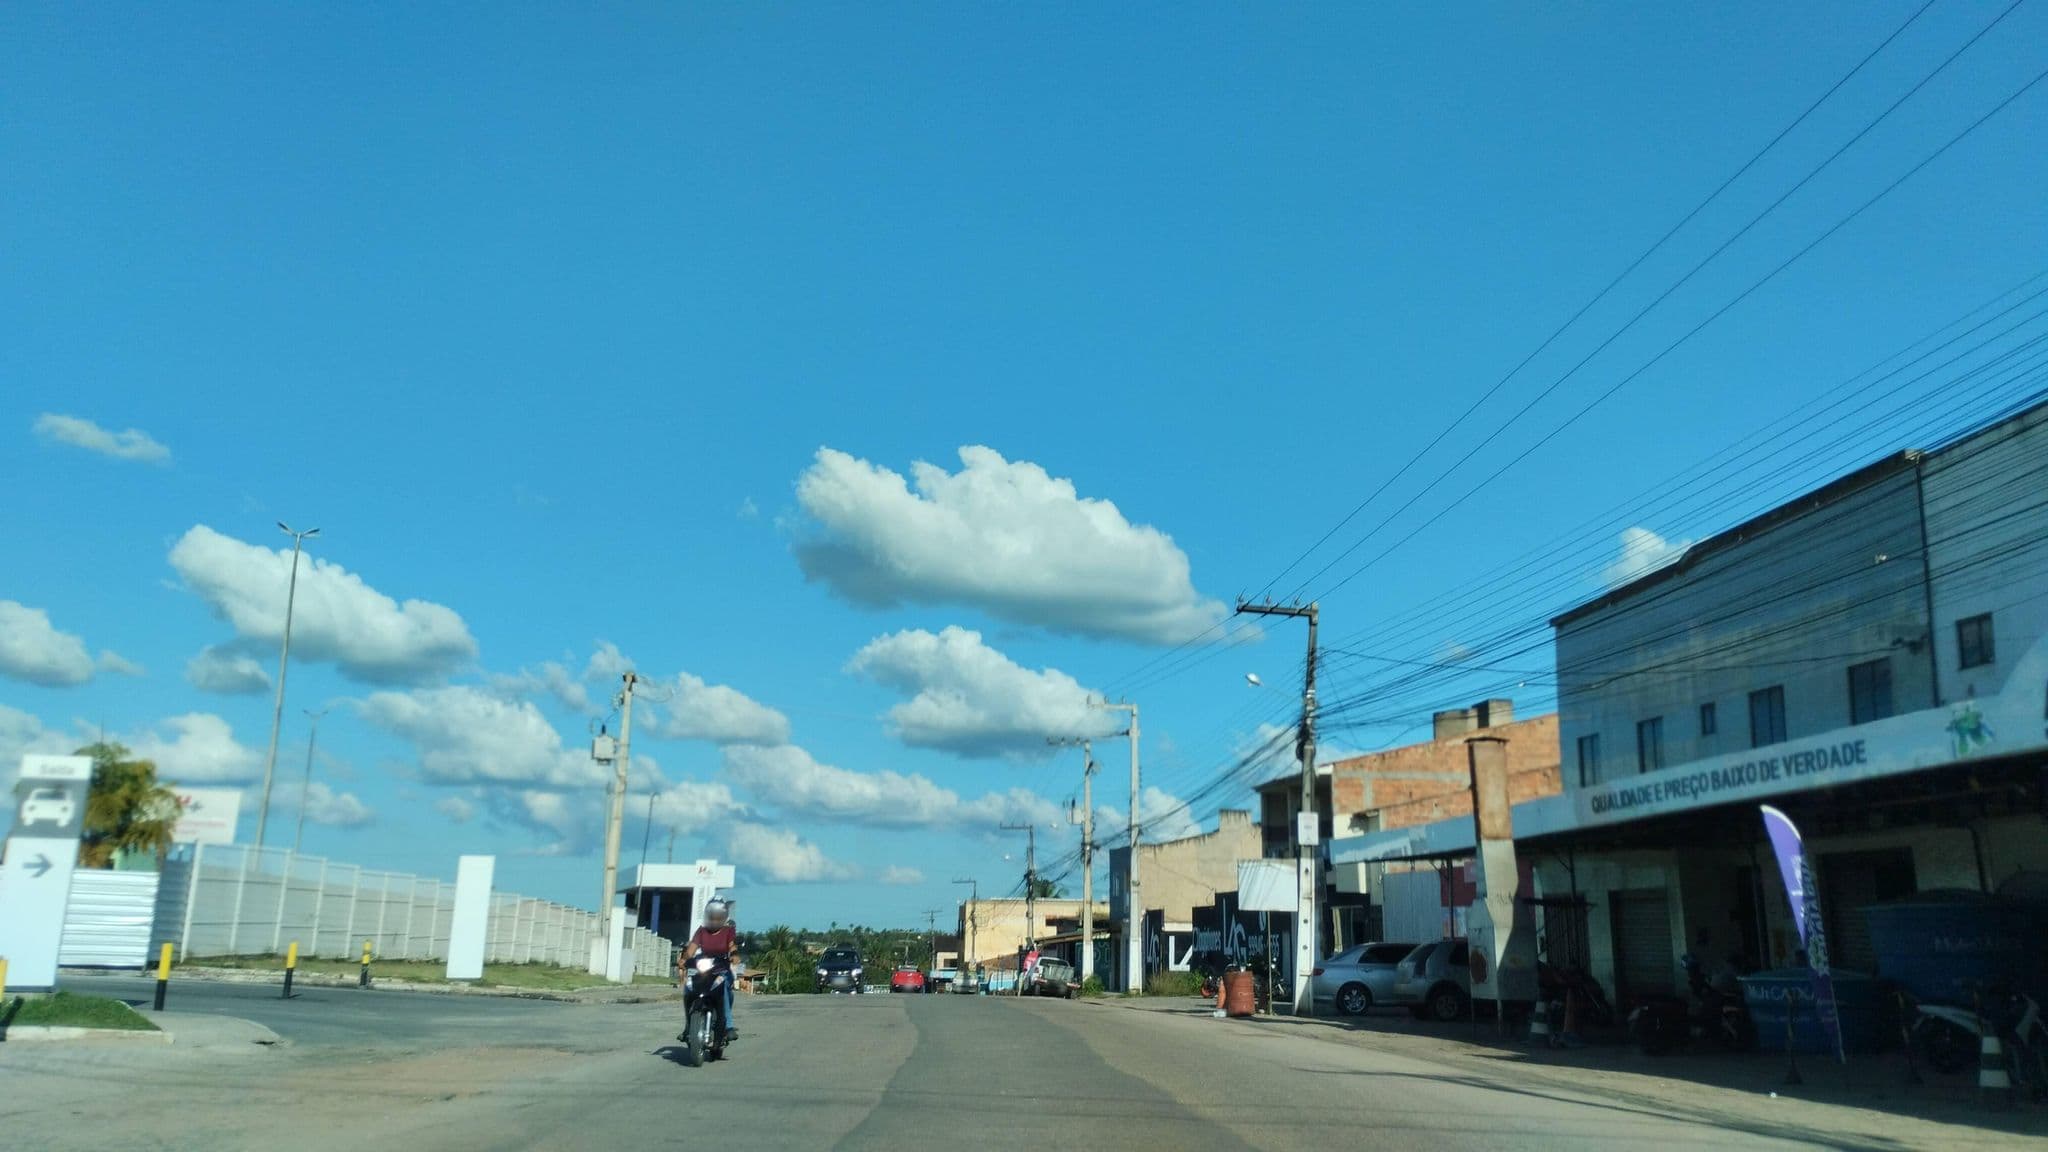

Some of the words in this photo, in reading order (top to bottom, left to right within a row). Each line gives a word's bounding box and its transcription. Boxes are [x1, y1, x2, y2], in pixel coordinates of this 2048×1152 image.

[1591, 782, 1653, 814] QUALIDADE
[1654, 781, 1663, 803] E
[1664, 773, 1710, 801] PREÇO
[1710, 762, 1757, 791] BAIXO
[1759, 758, 1781, 783] DE
[1782, 740, 1867, 777] VERDADE
